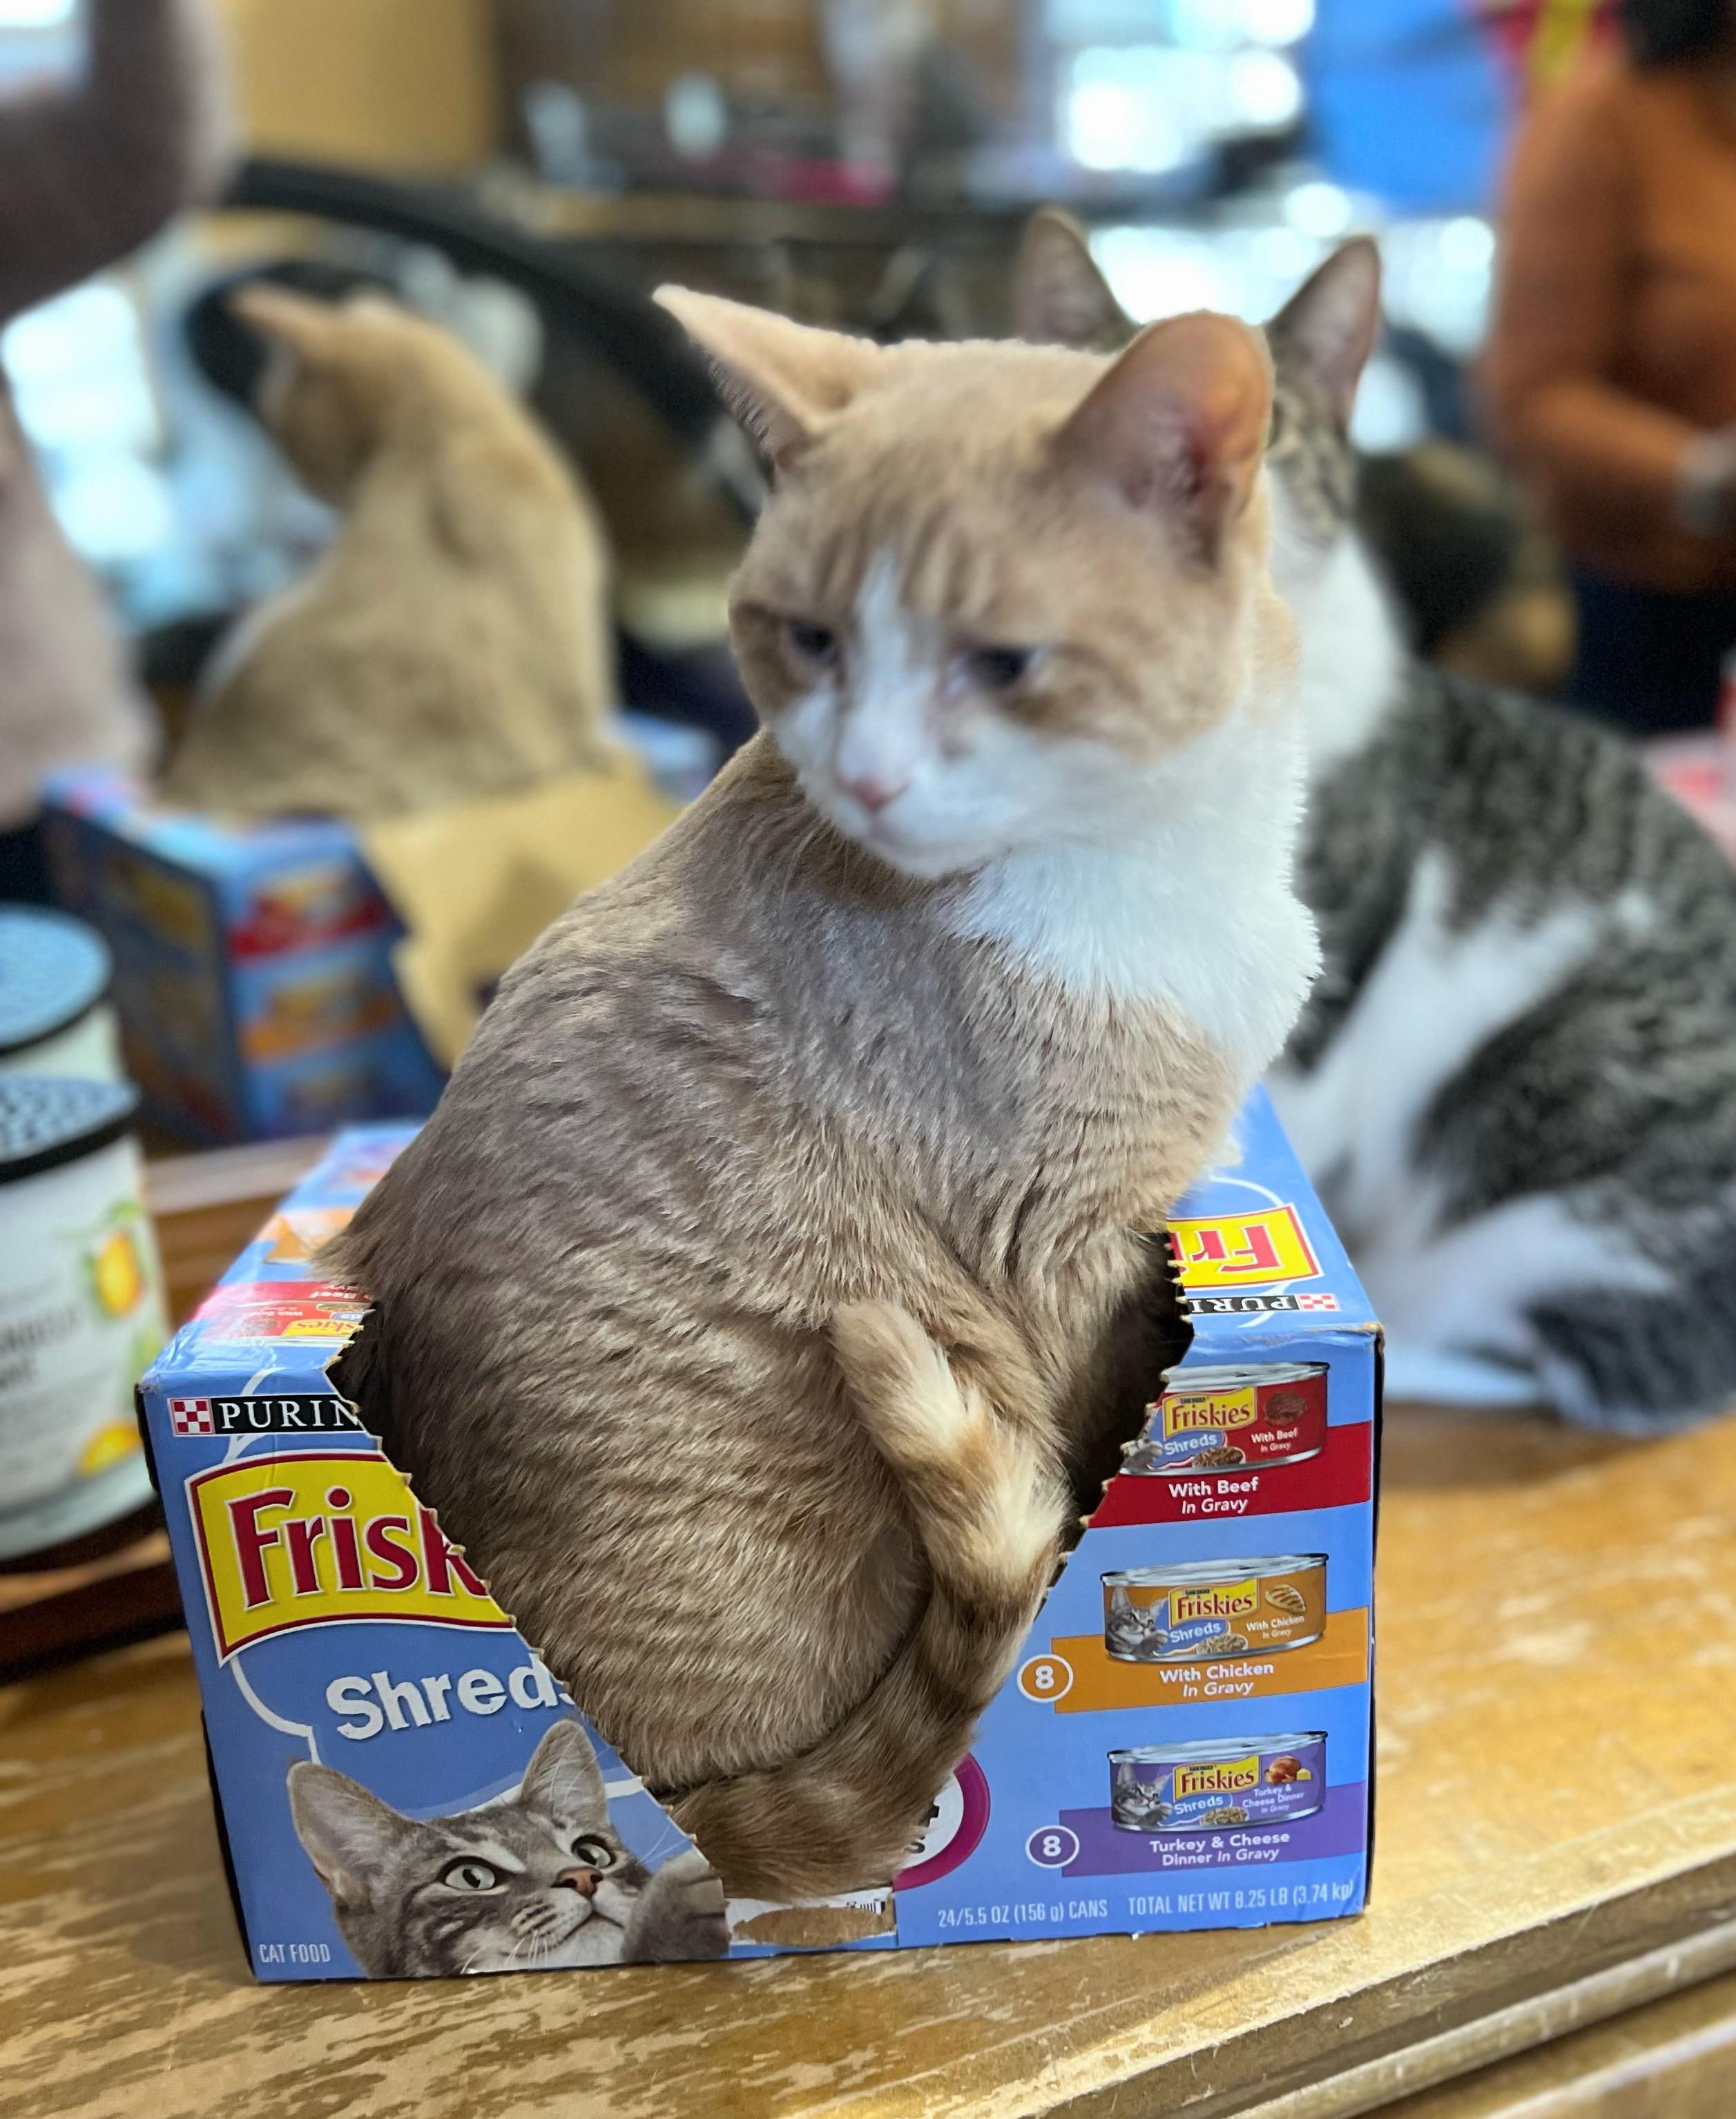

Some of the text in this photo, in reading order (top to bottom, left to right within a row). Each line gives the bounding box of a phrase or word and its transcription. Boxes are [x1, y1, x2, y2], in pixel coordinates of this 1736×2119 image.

[1171, 1402, 1251, 1430] Friskies
[1164, 1433, 1217, 1456] Shreds
[1251, 1427, 1298, 1444] With Beef
[1269, 1441, 1291, 1452] Gravy
[1169, 1477, 1259, 1498] With Beef
[1182, 1497, 1248, 1515] In Gravy
[1177, 1593, 1253, 1619] Friskies
[1170, 1622, 1221, 1643] Shreds
[1246, 1615, 1304, 1632] With Chicken
[1035, 1665, 1054, 1689] 8
[1160, 1662, 1274, 1683] With Chicken
[326, 1653, 575, 1741] Shred
[1183, 1680, 1254, 1697] In Gravy
[1182, 1770, 1254, 1794] Friskies
[1253, 1783, 1292, 1797] Turkey &
[1174, 1795, 1224, 1814] Shreds
[1242, 1792, 1304, 1808] Cheese Dinner
[1042, 1835, 1062, 1857] 8
[1149, 1833, 1290, 1852] Turkey & Cheese
[1162, 1848, 1280, 1866] Dinner In Gravy
[1128, 1895, 1173, 1915] TOTAL
[1177, 1893, 1204, 1912] NET
[1208, 1890, 1231, 1910] WT
[1235, 1888, 1265, 1909] 8.25
[1270, 1886, 1288, 1906] LB
[1293, 1883, 1328, 1907] (3.74
[938, 1899, 1108, 1928] 24/5.5 OZ (156 g) CANS
[259, 1943, 331, 1964] CAT FOOD
